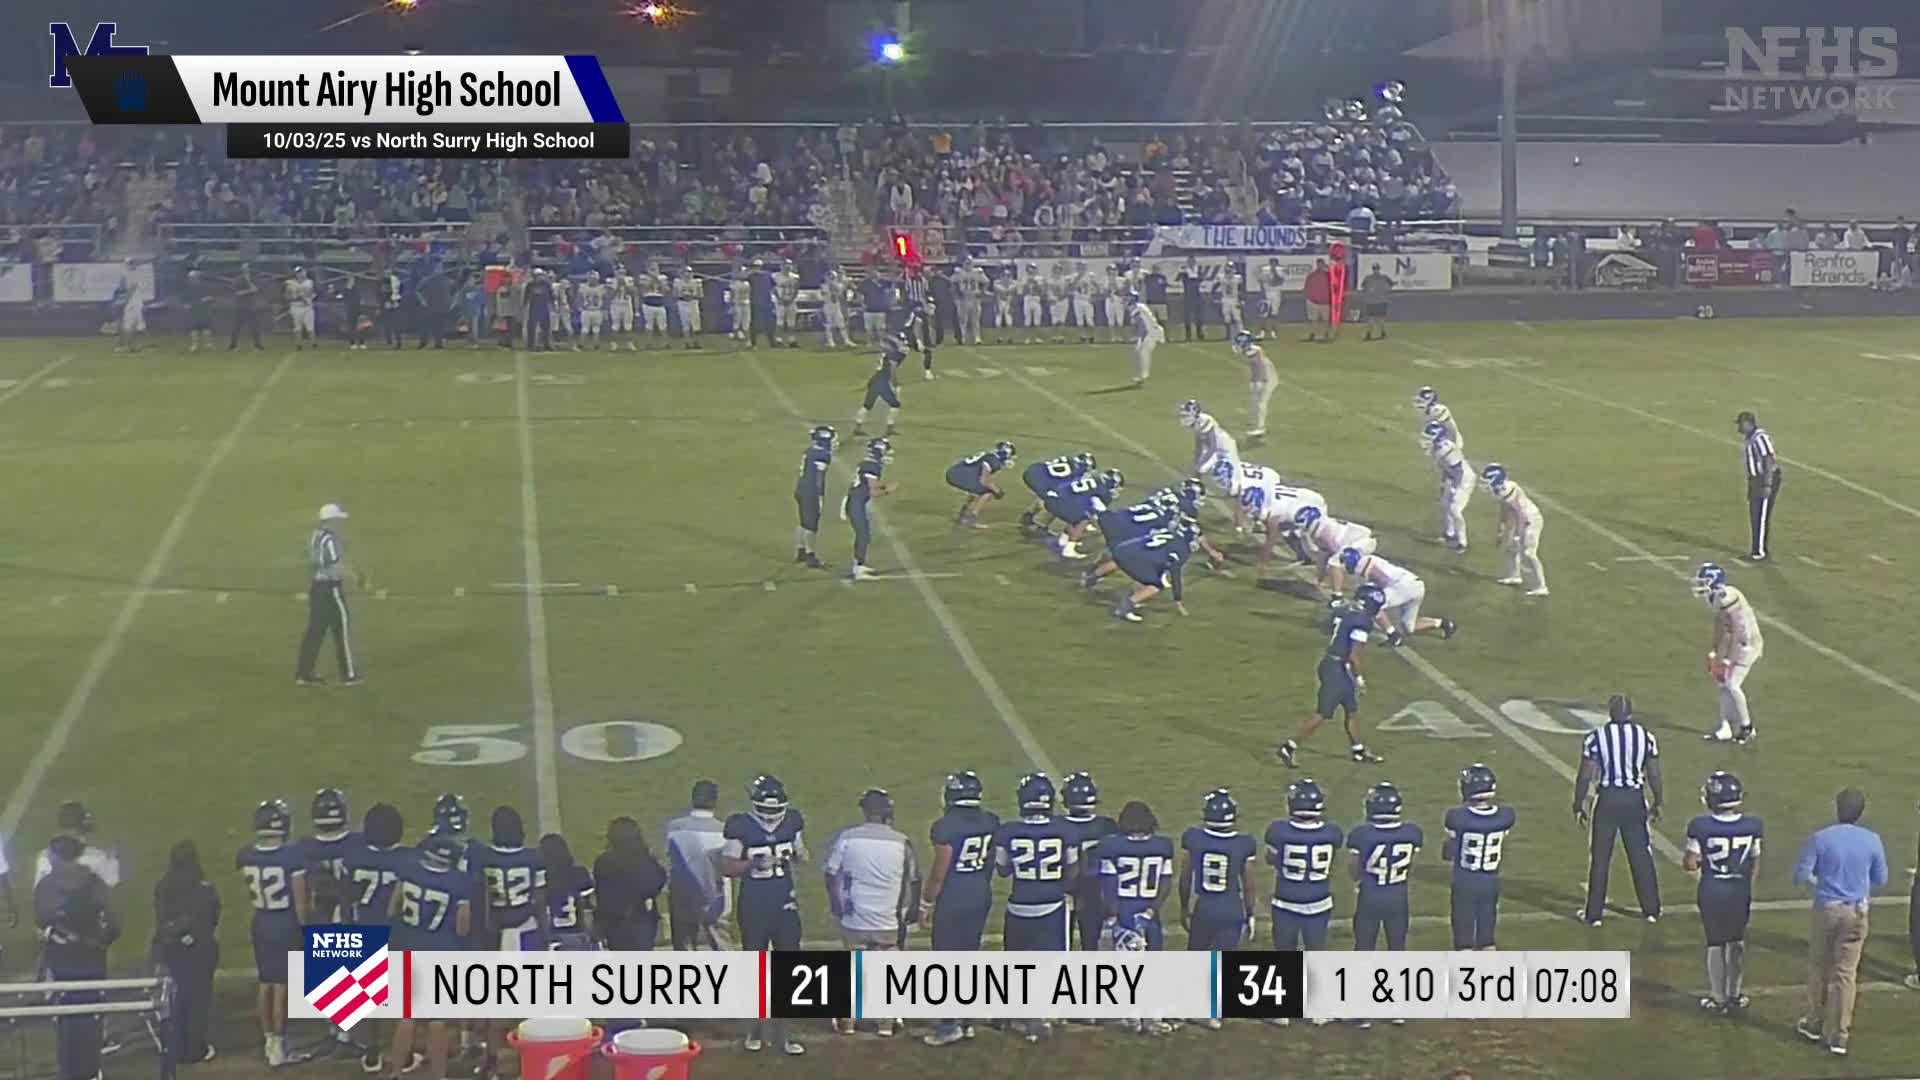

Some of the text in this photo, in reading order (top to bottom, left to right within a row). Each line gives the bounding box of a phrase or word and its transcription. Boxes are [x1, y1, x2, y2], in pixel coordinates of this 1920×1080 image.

[897, 236, 906, 257] 1
[1203, 226, 1306, 248] THE HOUNDS
[1803, 252, 1856, 270] Renfro
[1812, 267, 1865, 285] Brands
[410, 720, 684, 766] 50
[1011, 838, 1064, 880] 22
[1283, 844, 1333, 881] 59
[1366, 842, 1413, 886] 42
[1460, 831, 1502, 872] 88
[1705, 835, 1754, 873] 27
[1116, 856, 1161, 898] 20
[1203, 853, 1228, 892] 8
